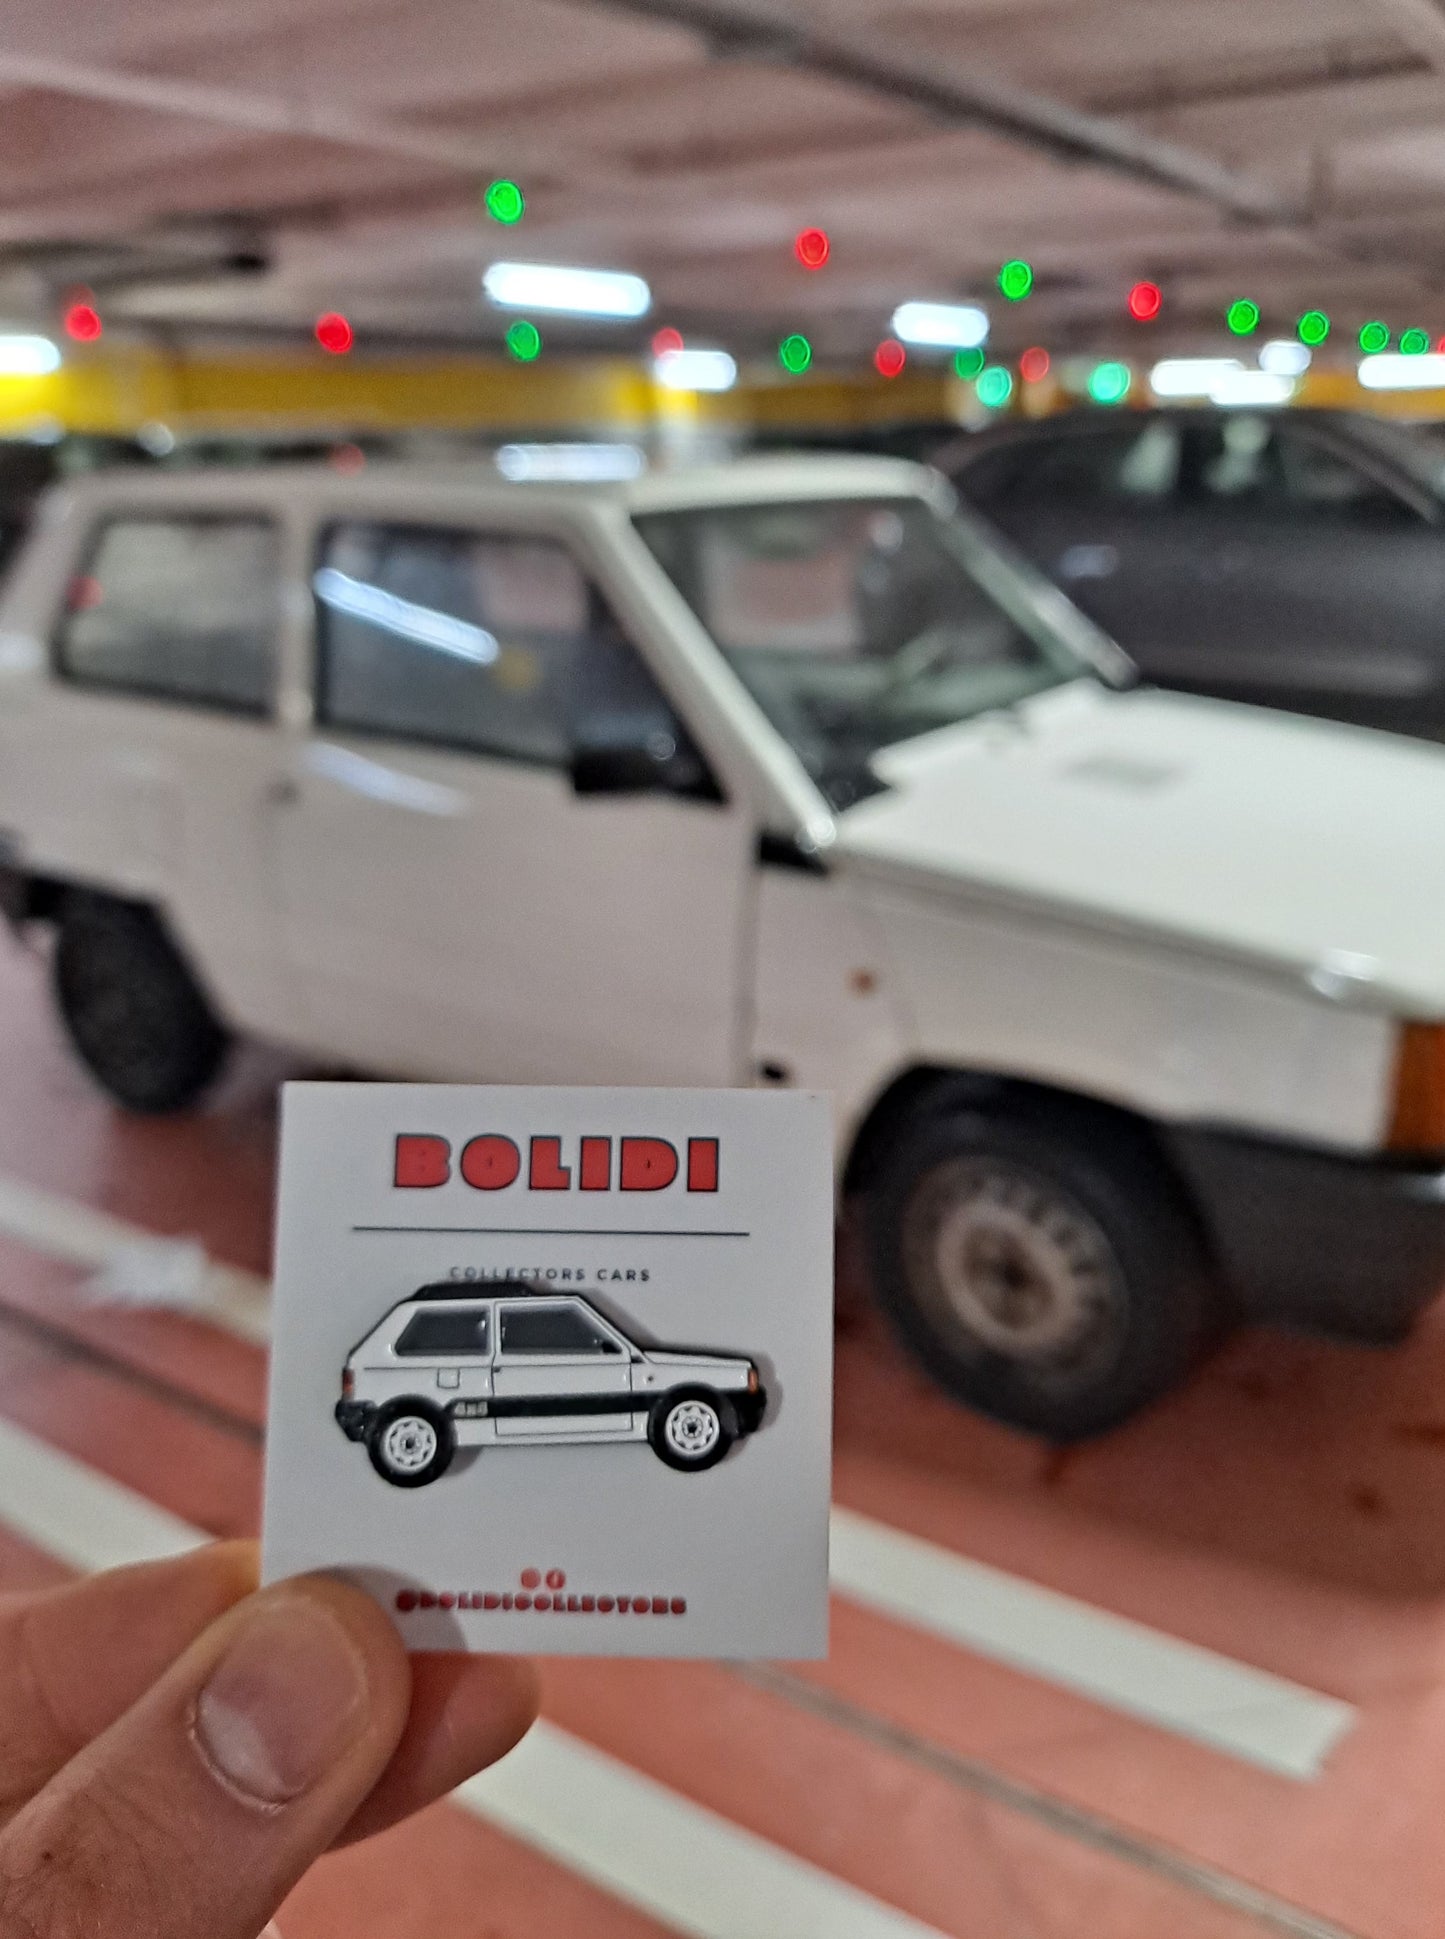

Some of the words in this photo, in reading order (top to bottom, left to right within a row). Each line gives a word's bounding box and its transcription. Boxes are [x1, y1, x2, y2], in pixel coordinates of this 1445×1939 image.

[394, 1133, 719, 1193] BOLIDI
[449, 1265, 586, 1281] COLLECTORS
[597, 1268, 651, 1282] CARS
